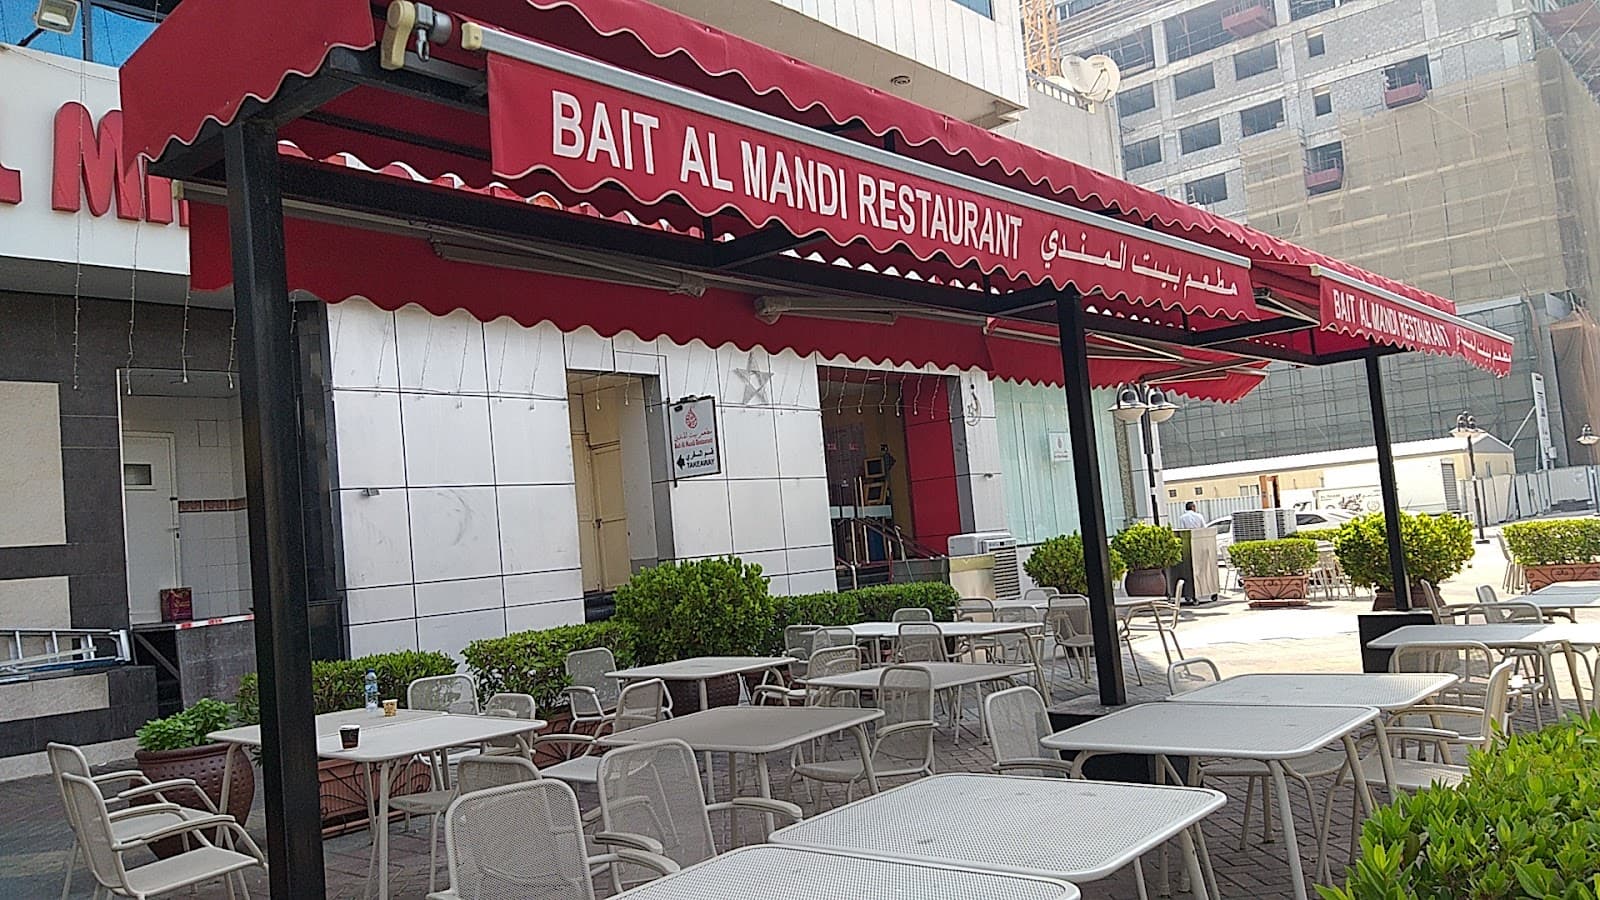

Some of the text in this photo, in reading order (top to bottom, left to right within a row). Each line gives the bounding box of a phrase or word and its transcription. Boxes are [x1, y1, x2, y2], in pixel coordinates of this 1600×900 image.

[552, 90, 1023, 260] BAIT AL MANDI RESTAURANT
[1041, 228, 1238, 299] مطعم بيت المندي
[1333, 289, 1451, 348] BAIT AL MANDI RESTAURANT
[687, 459, 715, 469] TAKEAWAY
